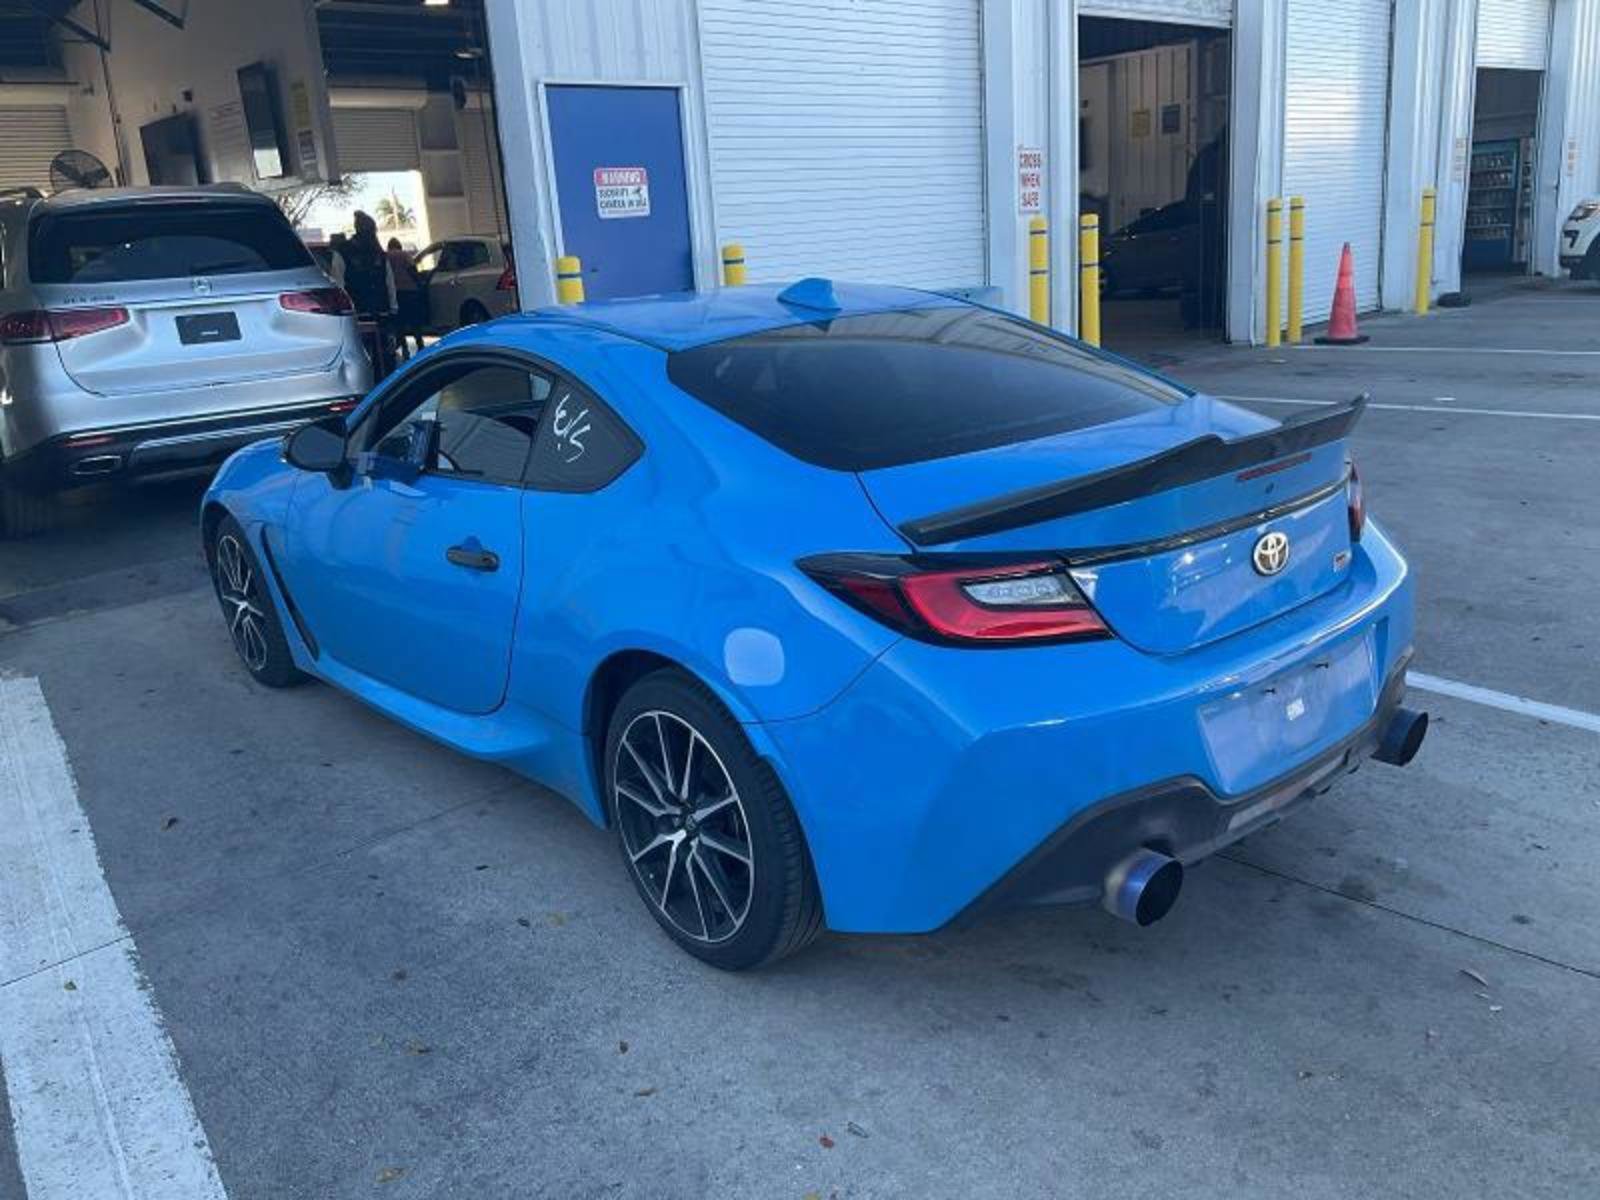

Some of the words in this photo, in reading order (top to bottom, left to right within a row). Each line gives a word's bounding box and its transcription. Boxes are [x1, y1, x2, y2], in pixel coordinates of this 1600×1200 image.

[1019, 153, 1041, 169] CROSS
[1021, 173, 1041, 188] WHEN
[1022, 191, 1039, 207] SAFE
